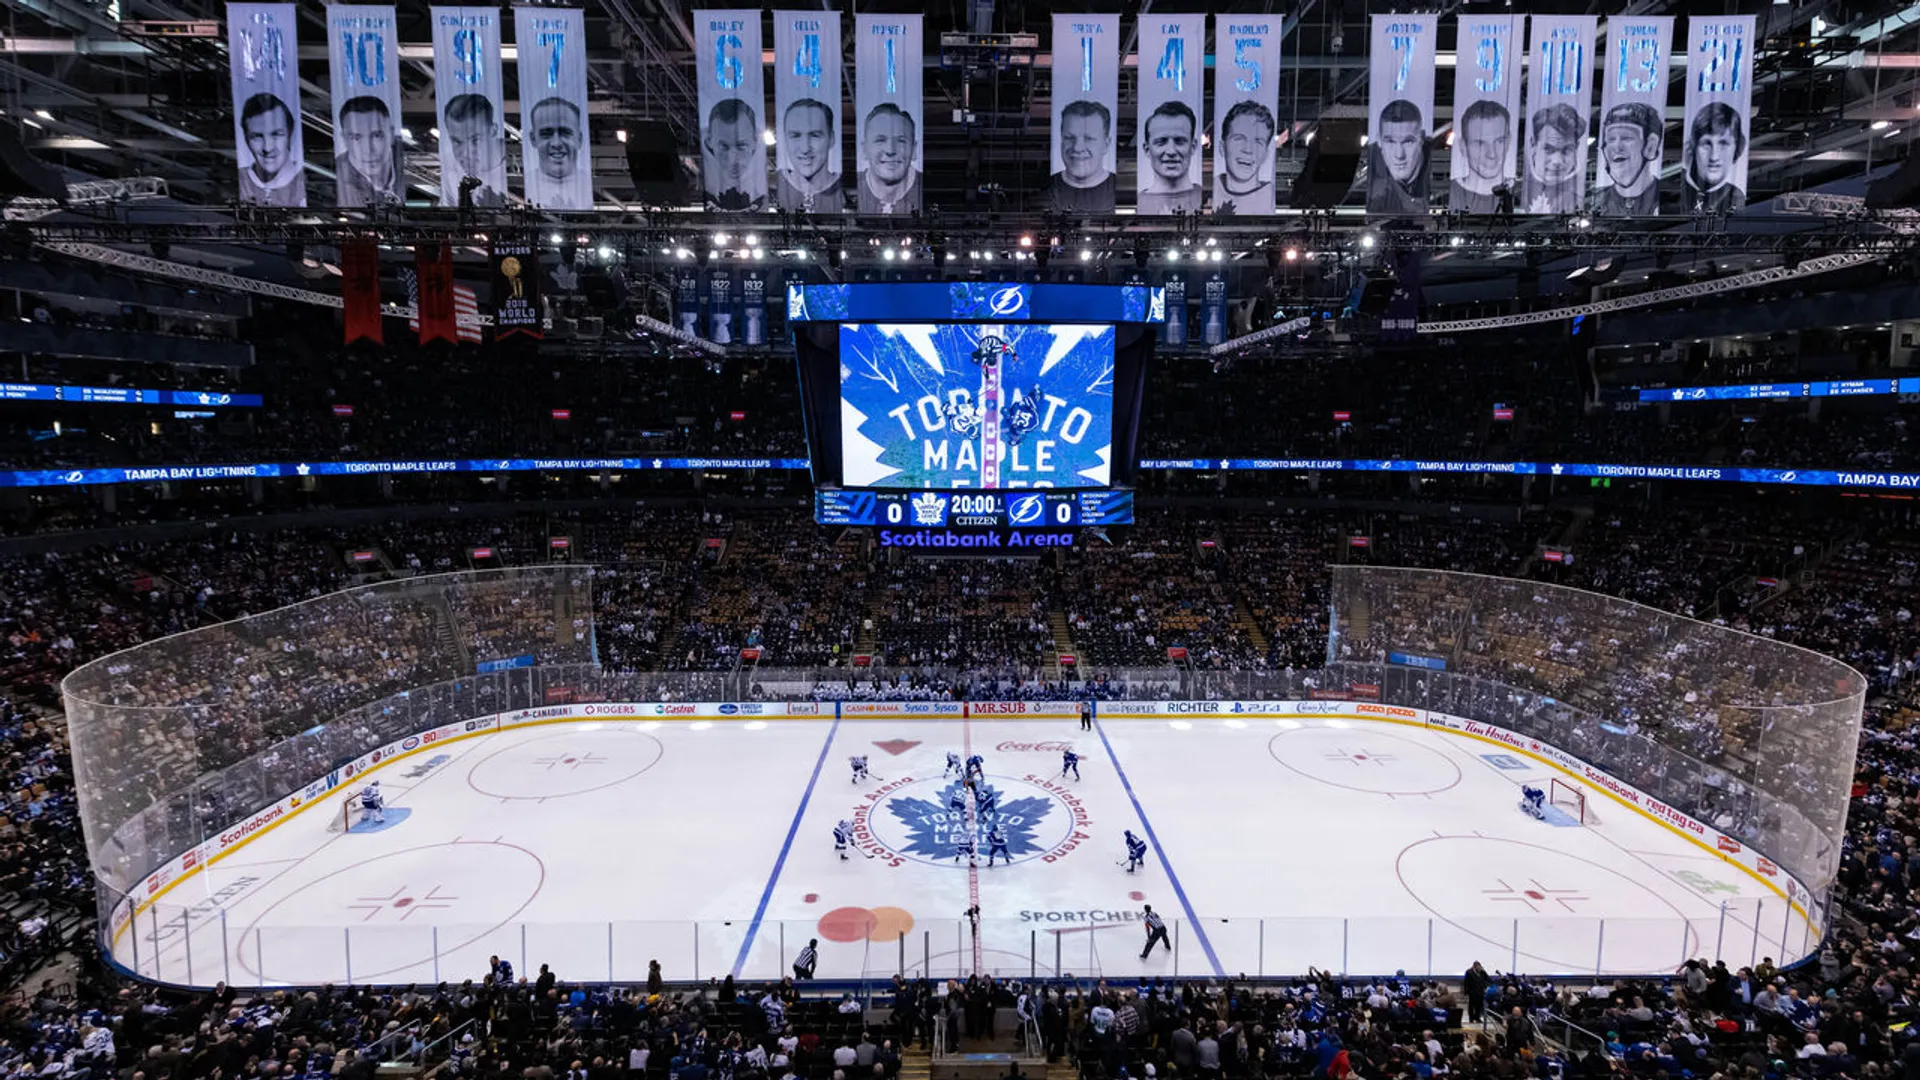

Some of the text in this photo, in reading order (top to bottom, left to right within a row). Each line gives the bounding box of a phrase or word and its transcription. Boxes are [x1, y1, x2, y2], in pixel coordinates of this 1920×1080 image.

[341, 32, 385, 86] 10
[452, 29, 482, 85] 9
[537, 33, 565, 88] 7
[716, 34, 744, 89] 6
[793, 35, 822, 88] 4
[1082, 37, 1093, 91] 1
[1390, 36, 1417, 91] 7
[884, 39, 896, 93] 1
[1157, 38, 1186, 91] 4
[1234, 39, 1262, 91] 5
[1476, 38, 1503, 92] 9
[1541, 41, 1583, 95] 10
[1617, 38, 1660, 92] 13
[1699, 39, 1743, 92] 21
[711, 280, 730, 290] 1922
[744, 280, 763, 290] 1932
[1165, 281, 1185, 291] 1964
[1206, 282, 1225, 291] 1967
[499, 308, 536, 317] WORLD
[345, 462, 456, 472] TORONTO MAPLE LEAFS
[534, 459, 623, 468] TAMPA BAY LIGHTNING
[1140, 460, 1193, 468] BAY LIGHTNING
[1254, 460, 1342, 468] TORONTO MAPLE LEAFS
[1416, 462, 1515, 472] TAMPA BAY LIGHTNING
[124, 466, 256, 480] TAMPA BAY LIGHTNING
[1598, 465, 1721, 479] TORONTO MAPLE LEAFS
[1837, 473, 1920, 486] TAMPA BAY
[951, 495, 994, 513] 20:00
[887, 503, 902, 523] 0
[1056, 503, 1071, 523] 0
[956, 516, 998, 525] CITIZEN
[880, 530, 1074, 547] Scotiabank Arena
[1405, 655, 1429, 667] IBM
[532, 708, 568, 718] CANADIAN
[597, 704, 635, 714] ROGERS
[665, 704, 696, 714] Castrol
[791, 704, 815, 713] intact
[905, 703, 929, 713] Sysco
[934, 703, 958, 713] Sysco
[1121, 704, 1156, 713] PEOPLES
[1167, 702, 1219, 713] RICHTER
[1248, 704, 1280, 712] PS4
[1356, 704, 1416, 717] pizza pizza
[1464, 720, 1525, 749] Tim Hortons
[382, 744, 395, 757] LG
[354, 759, 366, 773] LG
[1554, 752, 1582, 770] CANADA
[1585, 767, 1639, 804] Scotiabank
[1023, 773, 1093, 828] Scotiabank
[220, 805, 283, 848] Scotiabank
[853, 776, 913, 868] Scotiabank Arena
[1043, 832, 1090, 864] Arena
